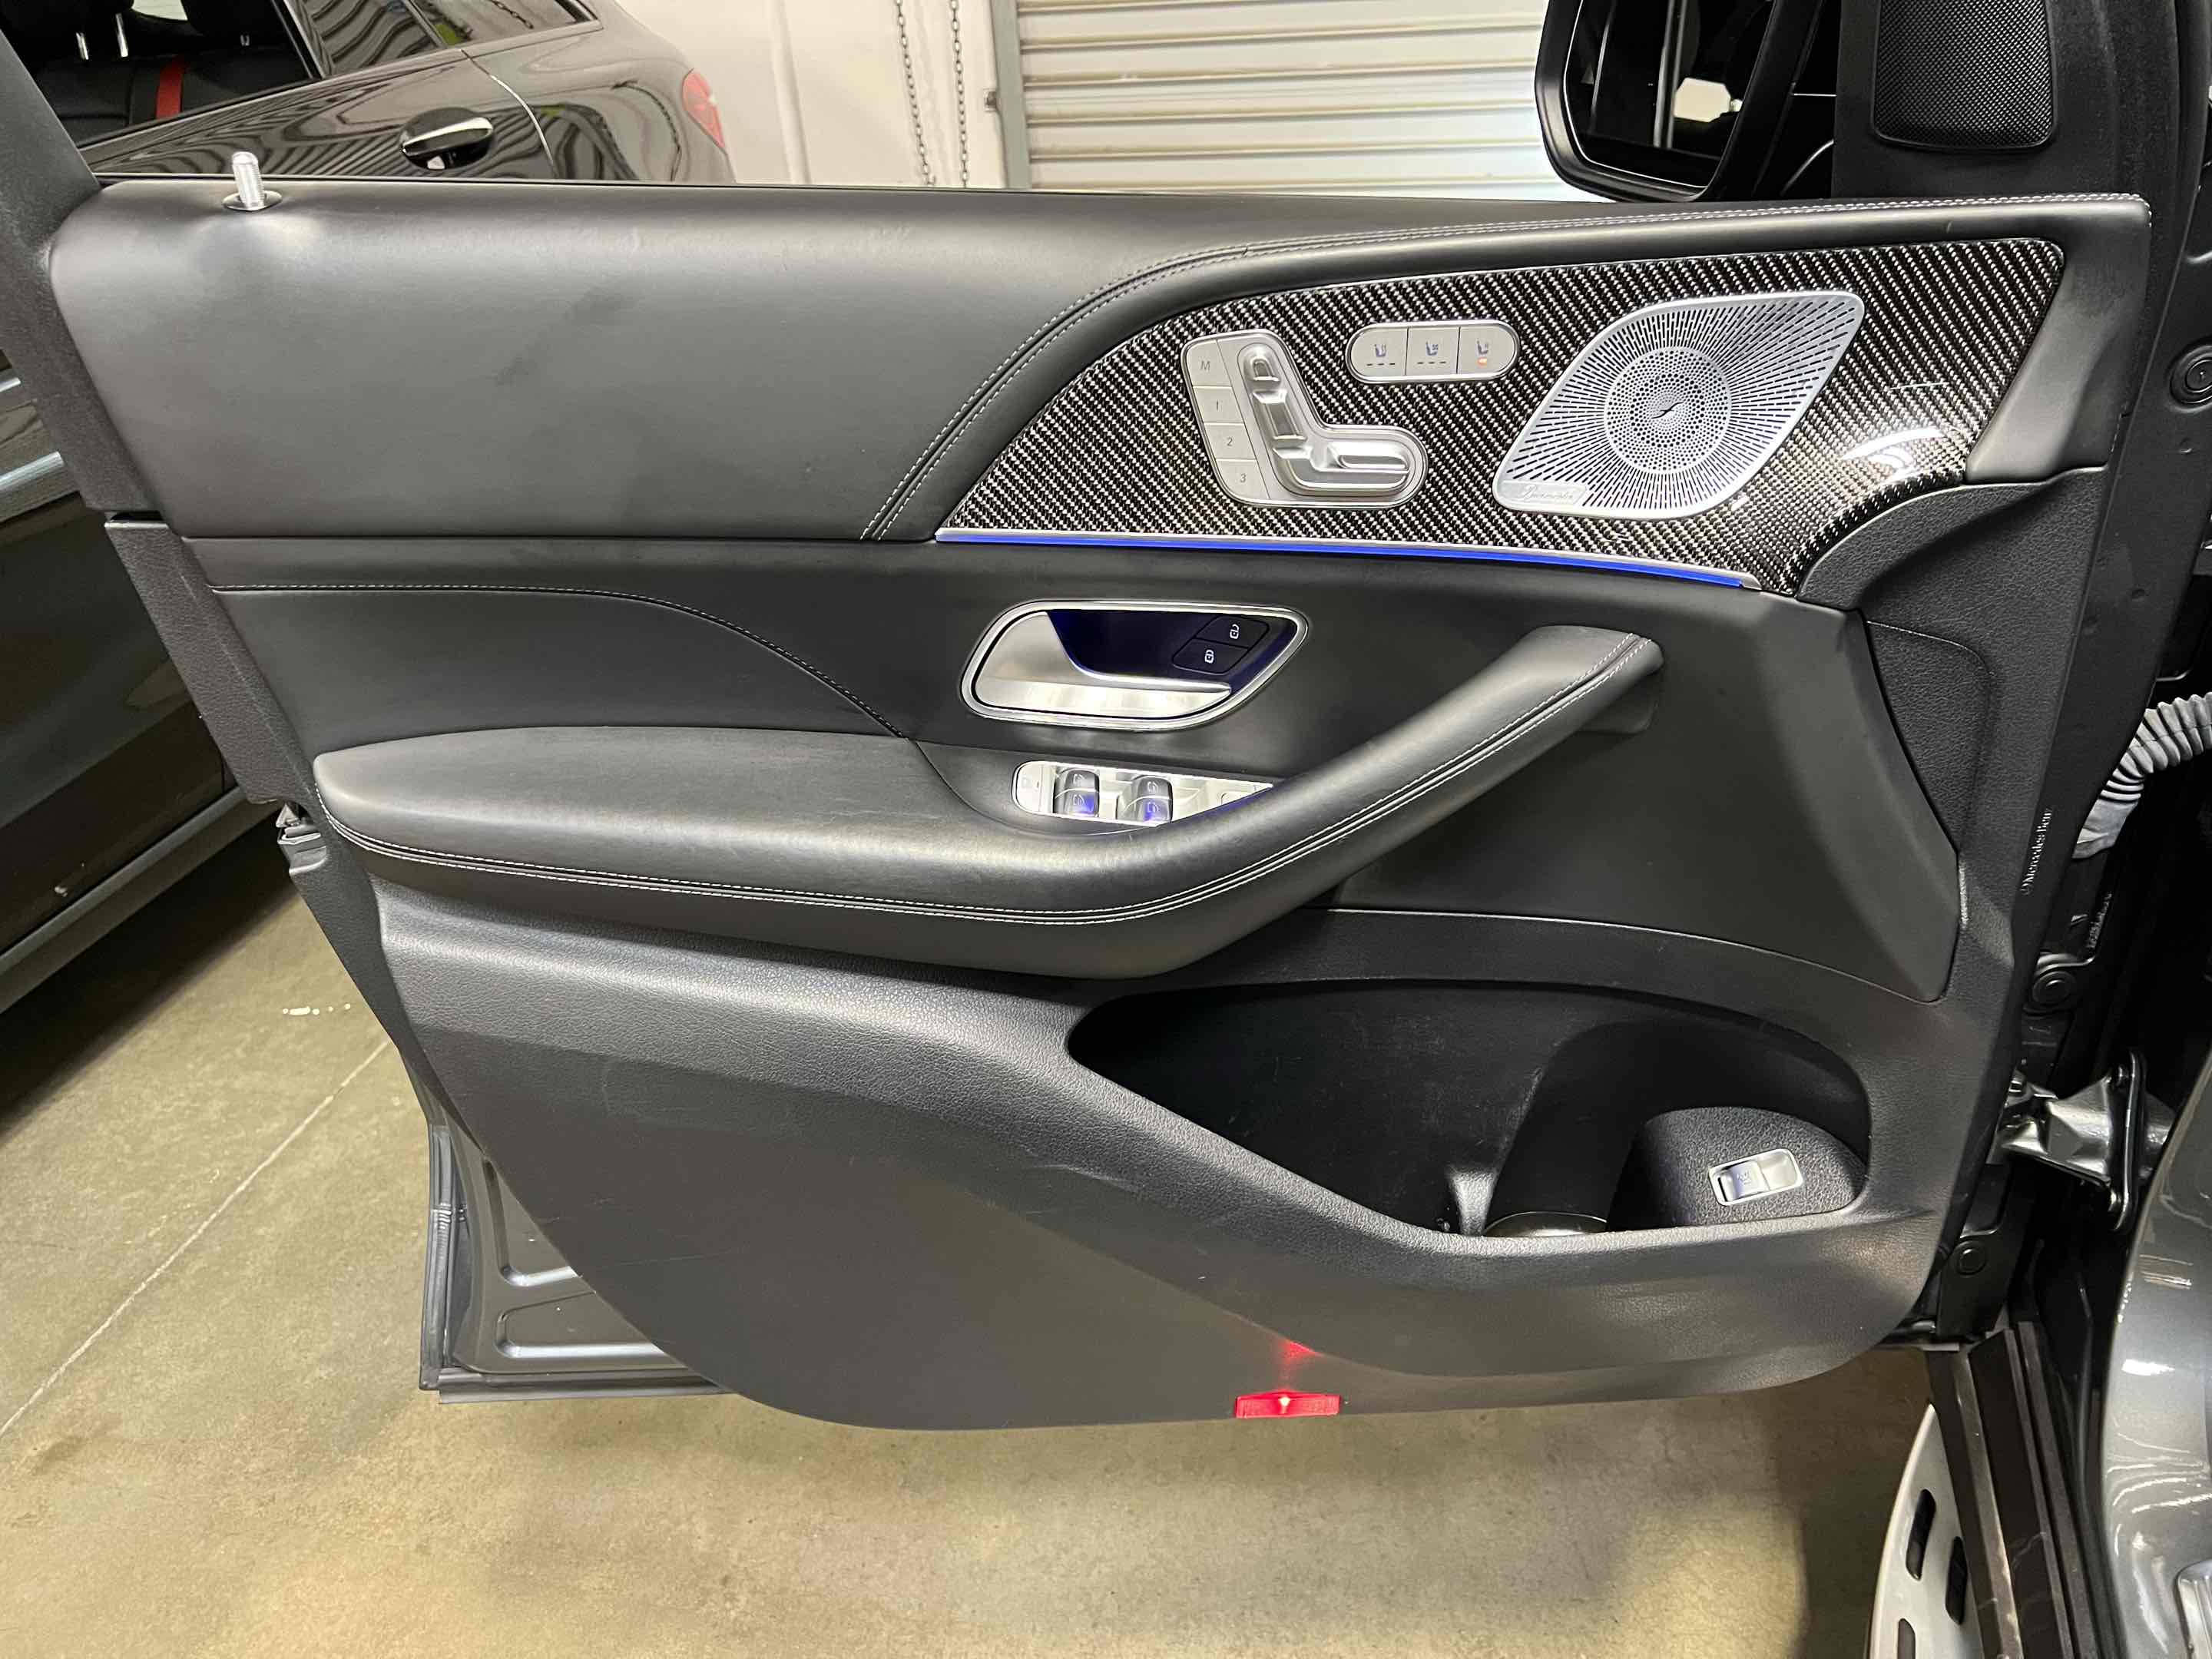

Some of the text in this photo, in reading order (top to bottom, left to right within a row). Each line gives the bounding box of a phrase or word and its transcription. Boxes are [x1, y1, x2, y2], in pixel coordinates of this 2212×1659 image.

[1200, 360, 1211, 372] M
[1226, 436, 1233, 447] 2
[1239, 472, 1247, 484] 3
